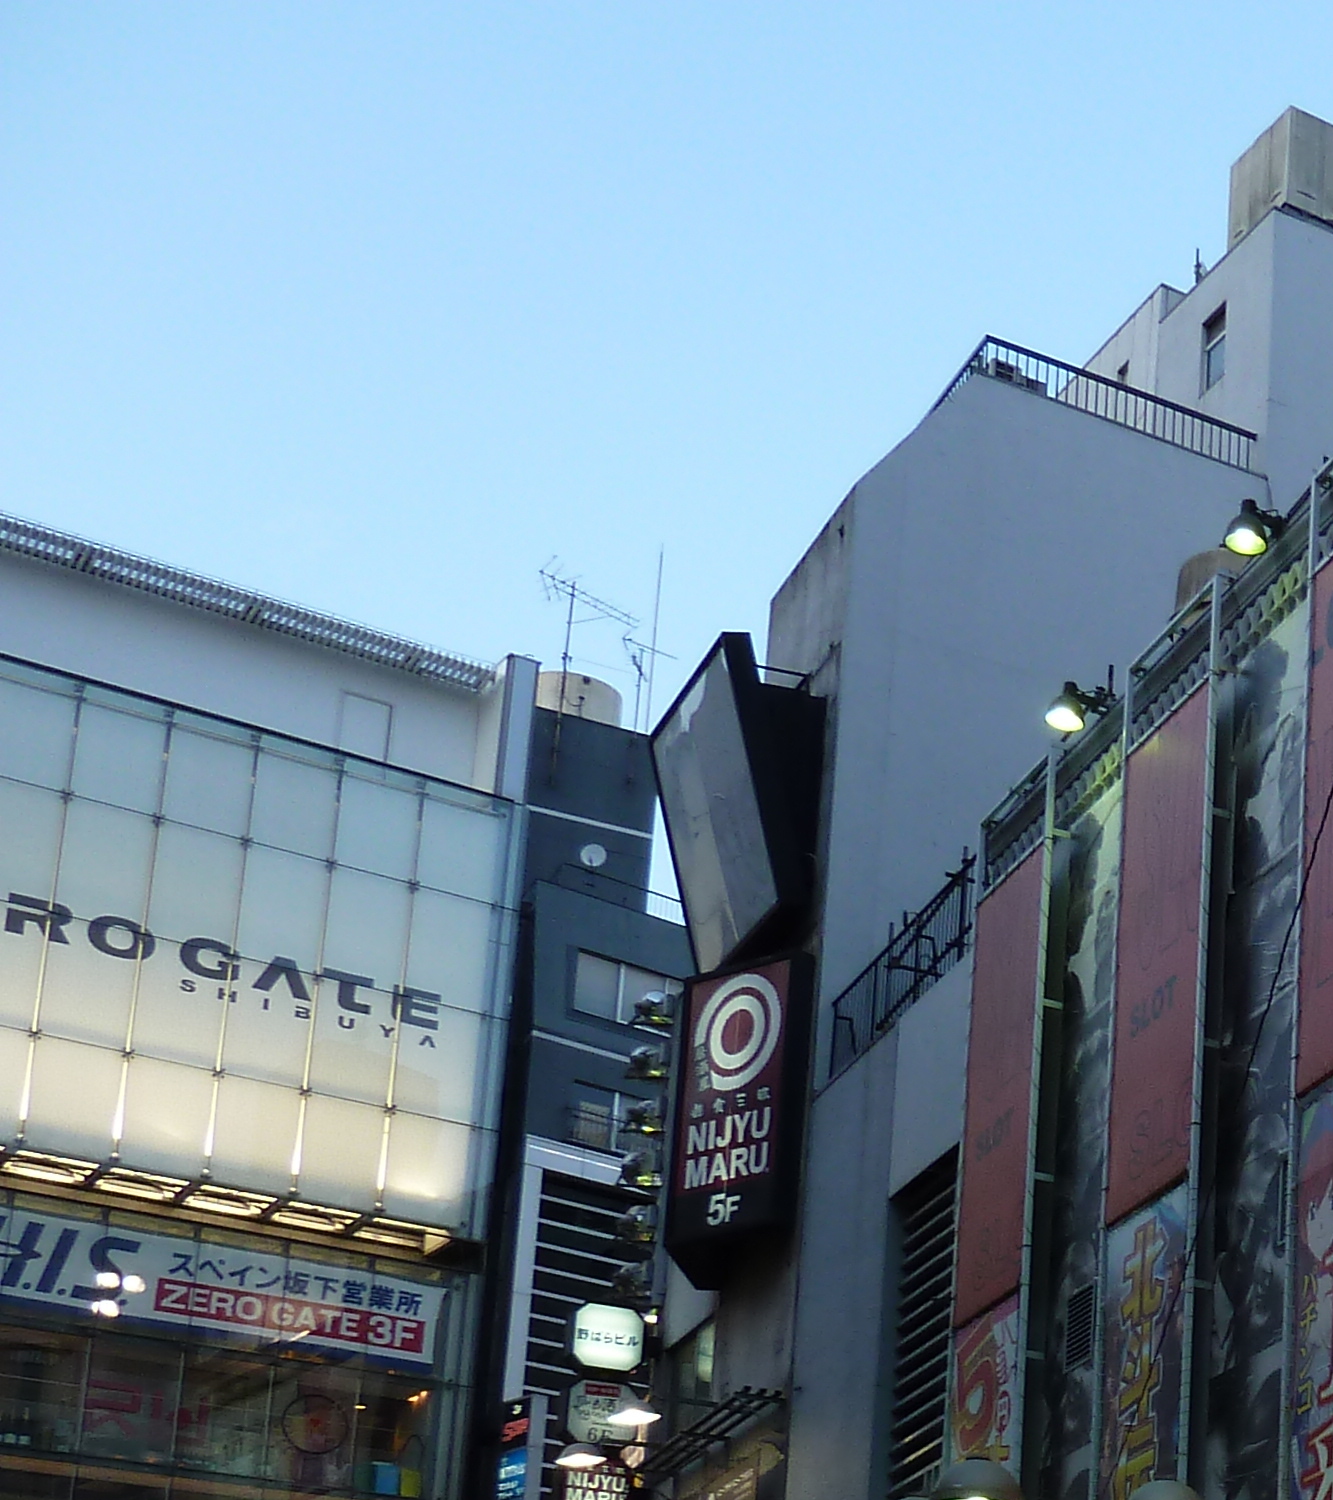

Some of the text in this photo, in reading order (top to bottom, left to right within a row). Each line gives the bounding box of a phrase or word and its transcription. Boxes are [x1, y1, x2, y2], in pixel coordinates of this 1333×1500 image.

[180, 977, 436, 1049] SHIBUYA
[687, 1106, 771, 1155] NIJYU
[683, 1141, 770, 1190] MARU
[706, 1193, 741, 1226] 5F
[169, 1250, 423, 1317] スペイン坂下営業所
[160, 1283, 419, 1354] ZERO GATE 3F
[576, 1326, 639, 1348] 野ばらビル
[1297, 1272, 1319, 1416] パチンコ
[566, 1471, 627, 1495] NIJYU
